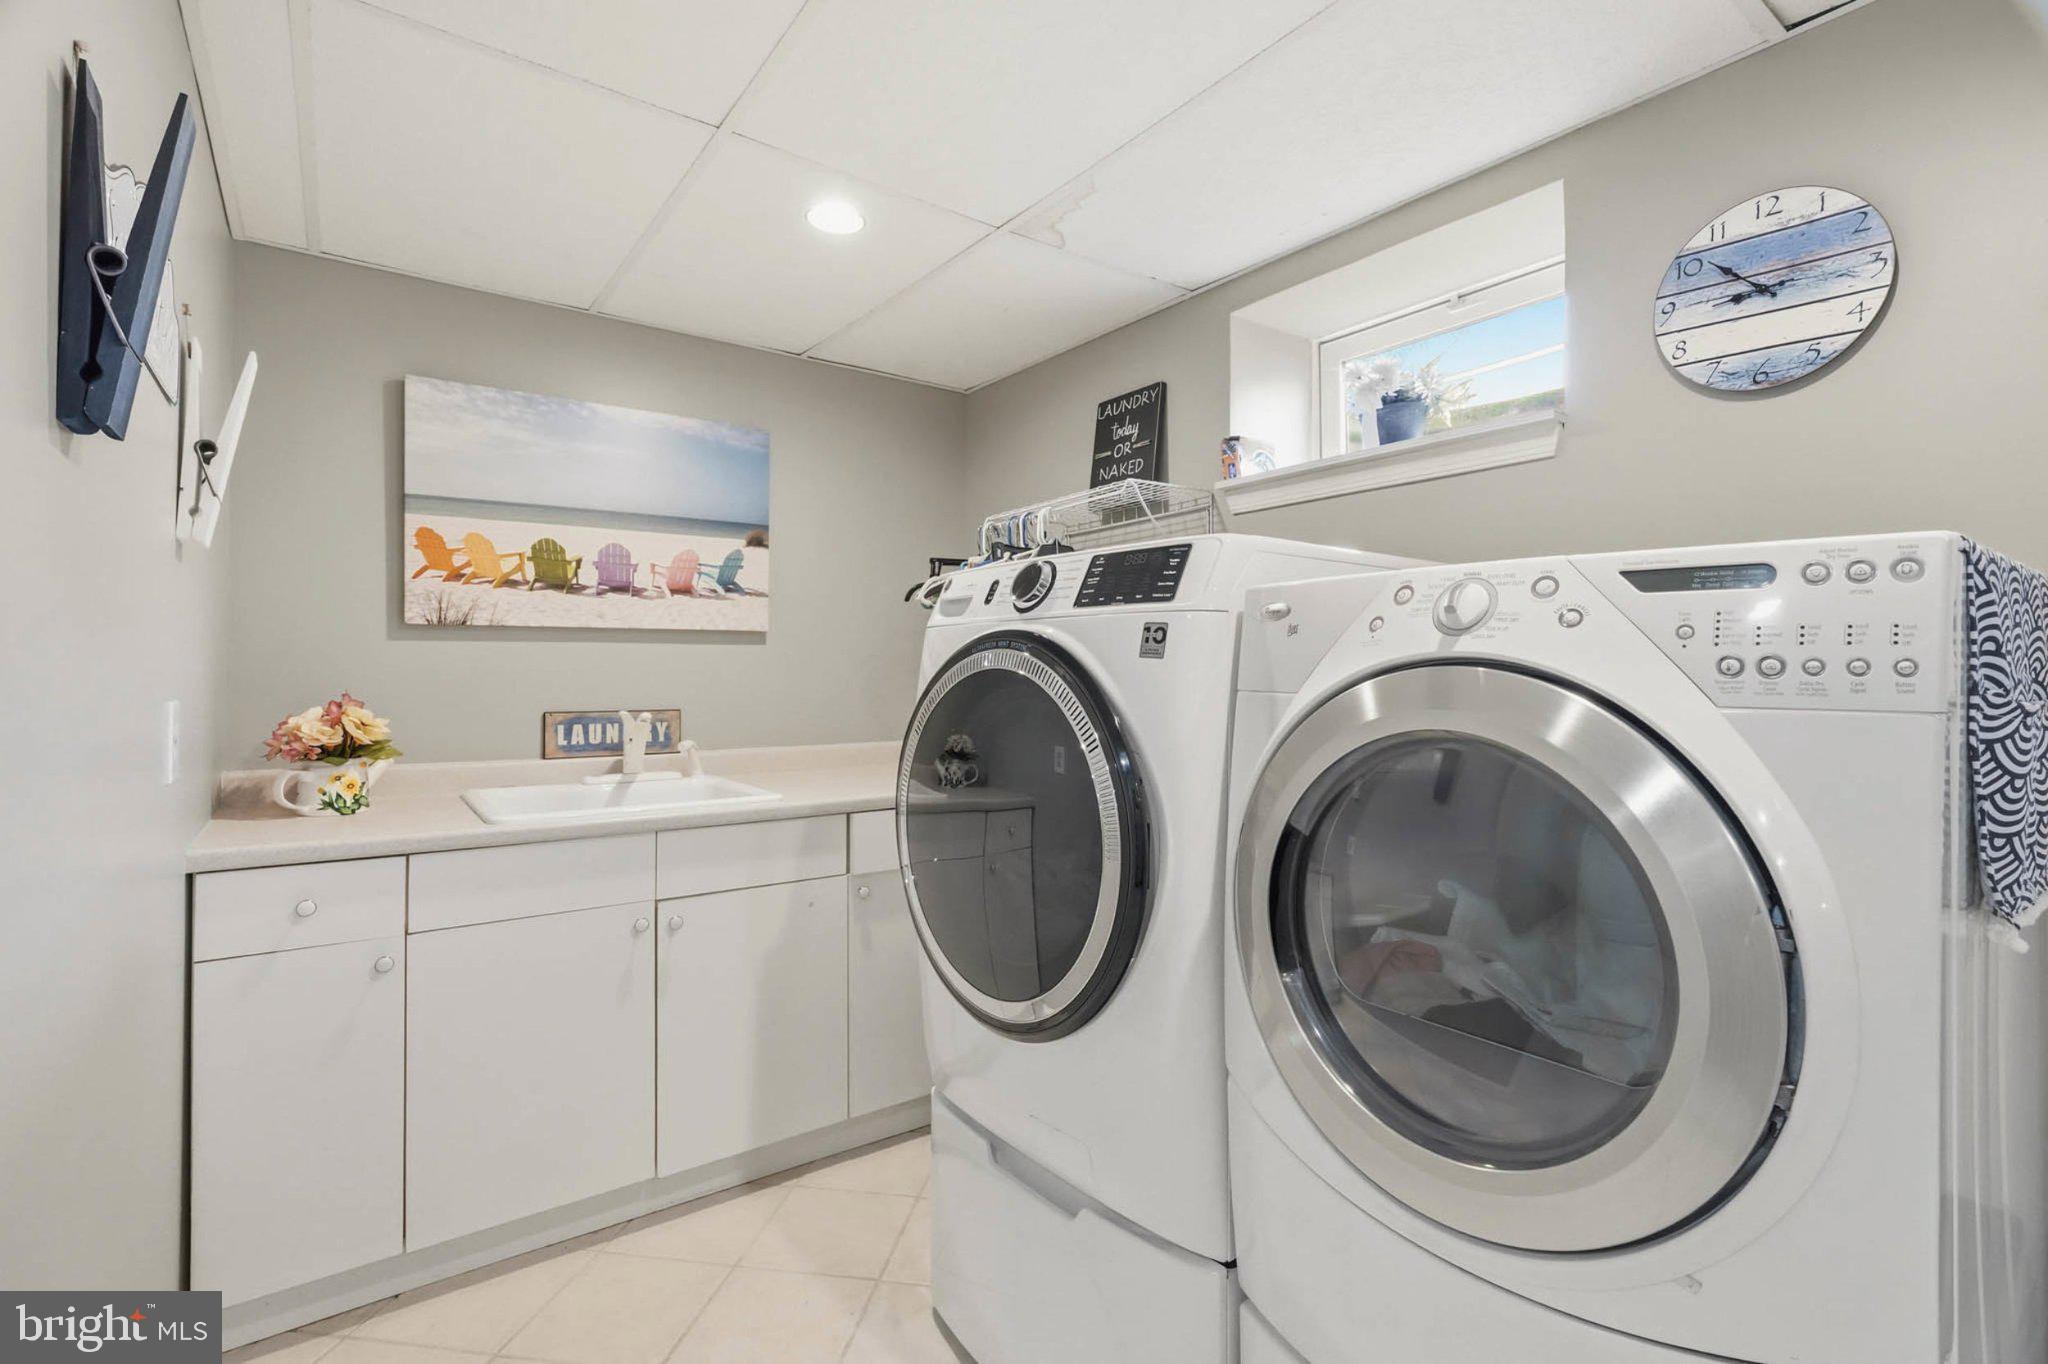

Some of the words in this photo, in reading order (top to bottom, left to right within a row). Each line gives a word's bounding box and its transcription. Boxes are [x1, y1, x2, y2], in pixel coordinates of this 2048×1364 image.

[1755, 195, 1783, 220] 12
[1709, 221, 1727, 242] 11
[1852, 211, 1873, 235] 2
[1676, 257, 1703, 281] 10
[1869, 251, 1888, 279] 3
[1659, 302, 1677, 328] 9
[1846, 300, 1872, 323] 4
[1672, 340, 1687, 361] 8
[1805, 342, 1822, 366] 5
[1705, 359, 1726, 385] 7
[1752, 359, 1769, 384] 6
[1097, 387, 1159, 420] LAUNDRY
[1111, 415, 1139, 442] today
[1113, 442, 1132, 458] OR
[1099, 458, 1144, 480] NAKED
[556, 721, 669, 746] LAUNY
